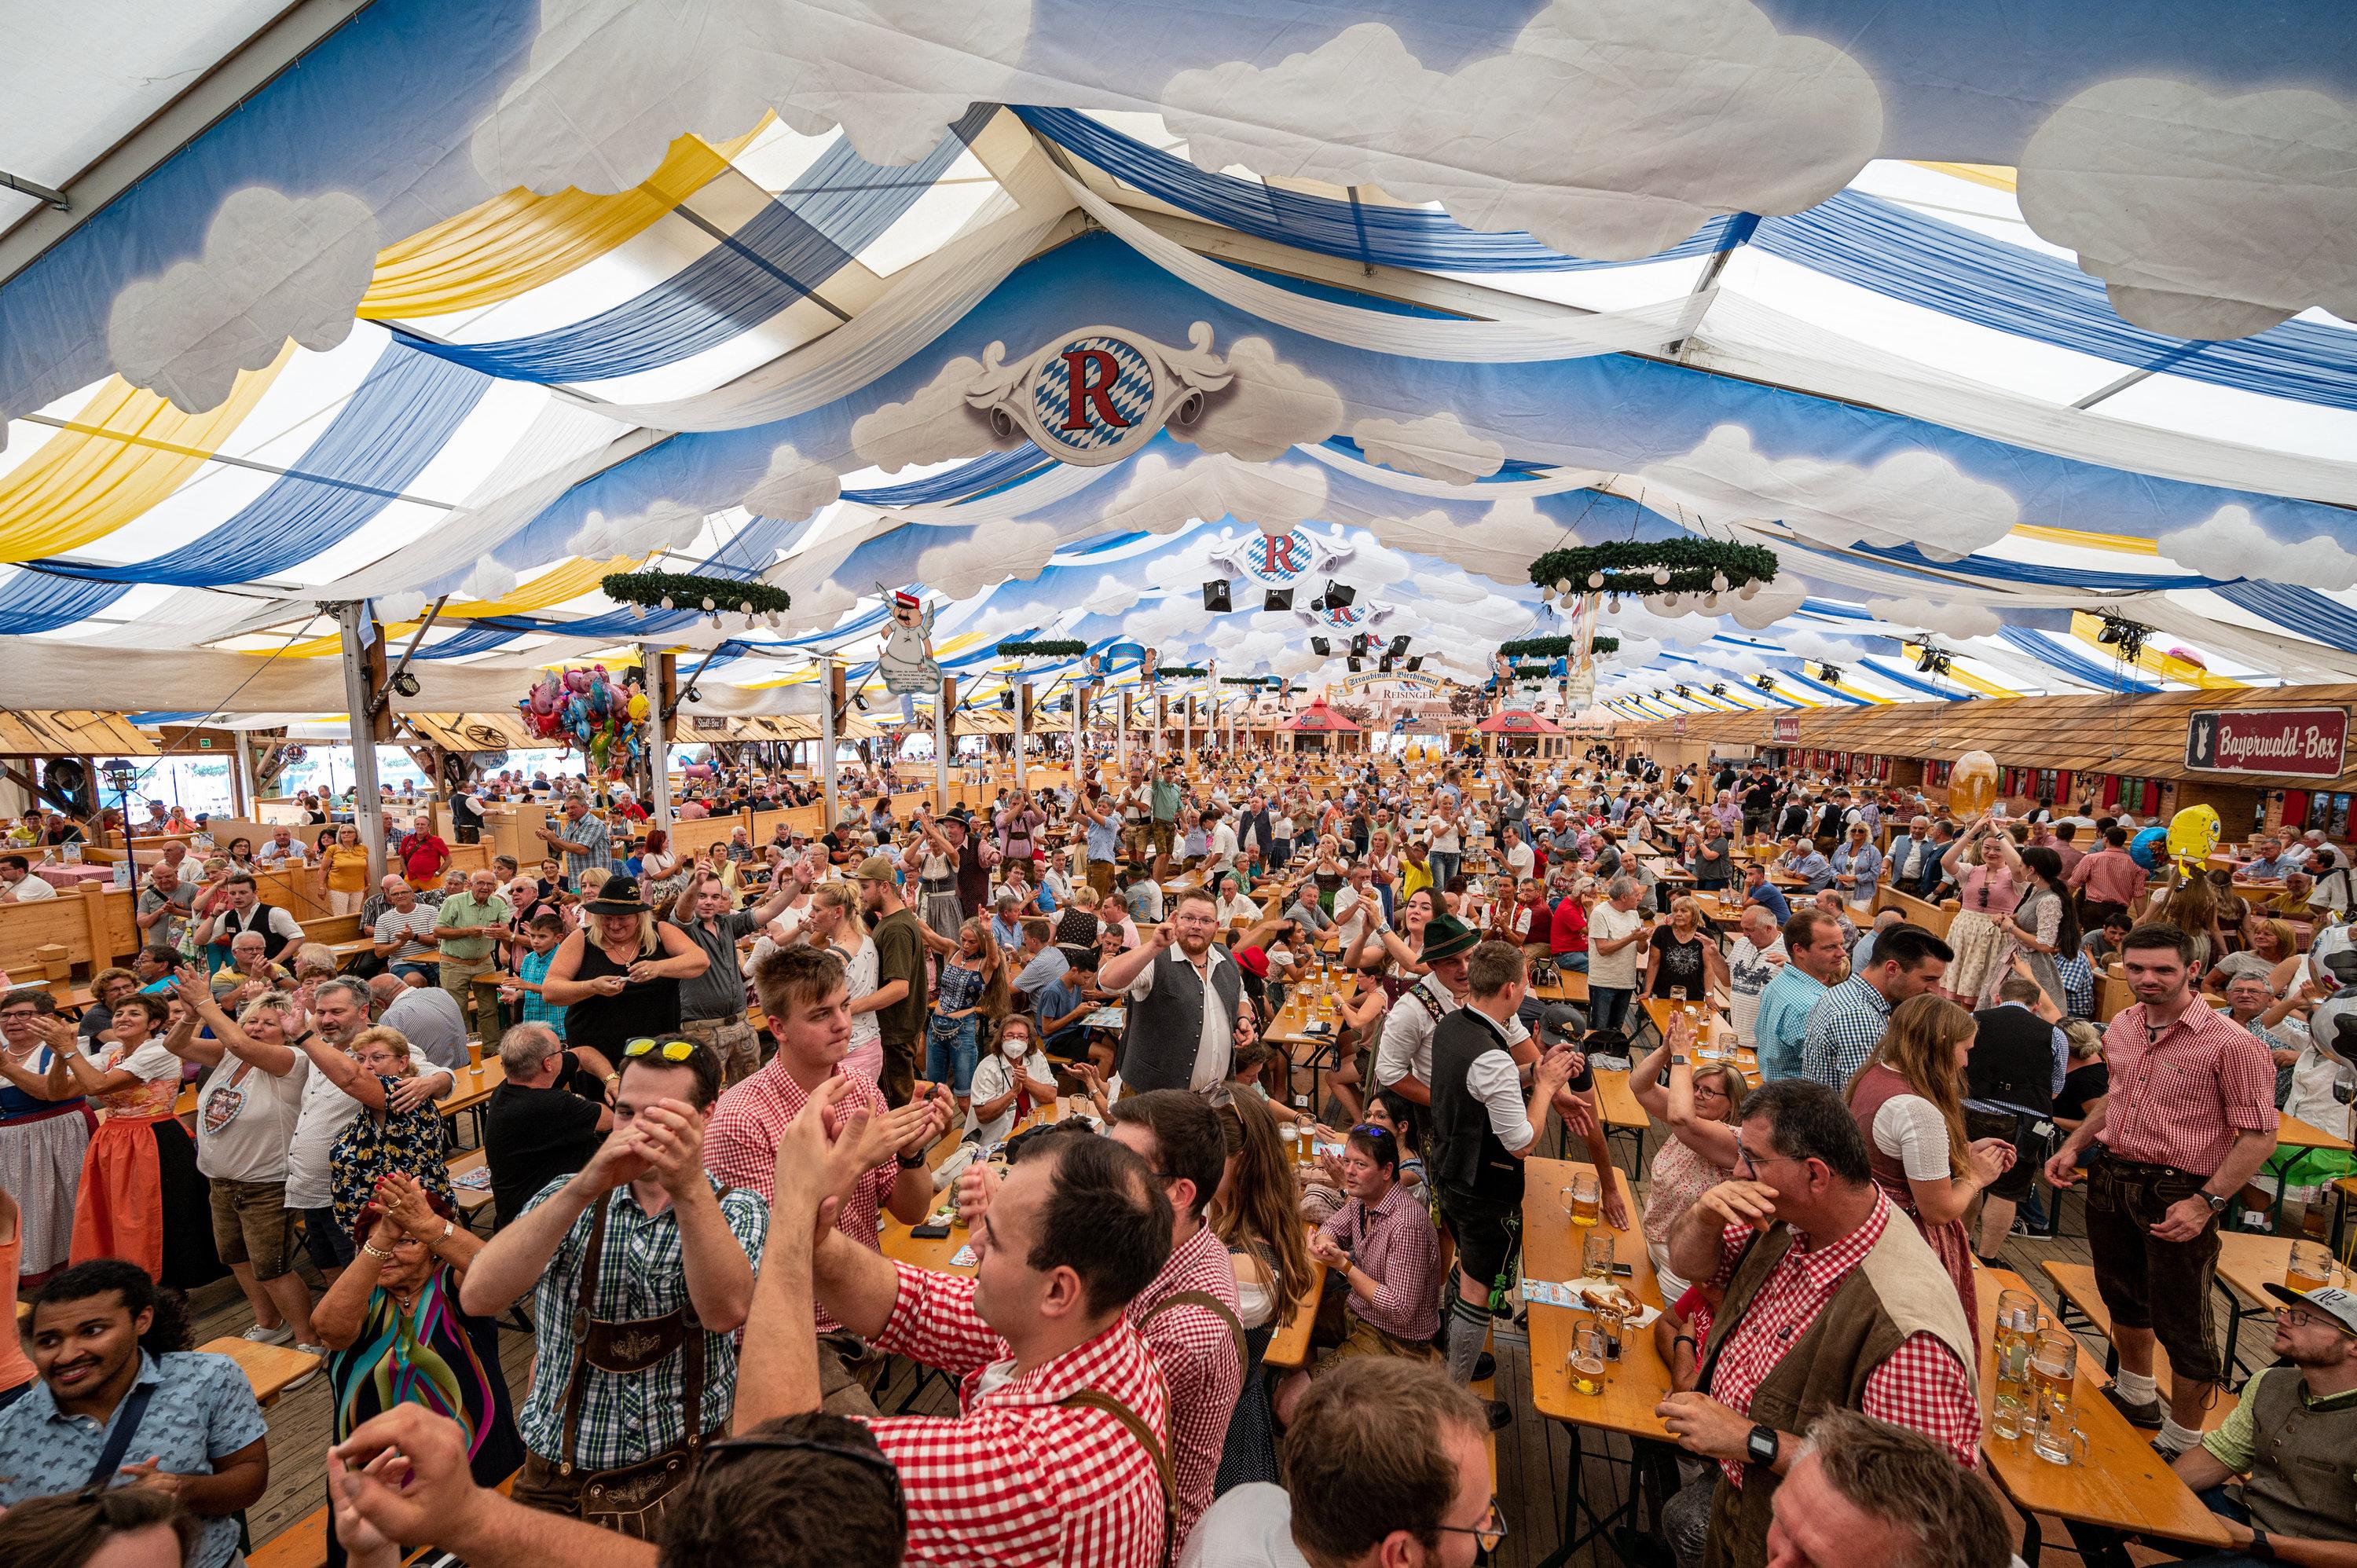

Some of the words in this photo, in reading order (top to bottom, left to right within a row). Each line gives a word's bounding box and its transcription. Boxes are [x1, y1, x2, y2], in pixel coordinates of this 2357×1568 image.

[1061, 350, 1131, 430] R
[1261, 534, 1299, 573] R
[1347, 672, 1393, 687] Straubinger
[1396, 671, 1440, 687] Bierhimmel
[1384, 689, 1435, 698] REISINGER
[2220, 725, 2337, 764] Bayerwald-Box
